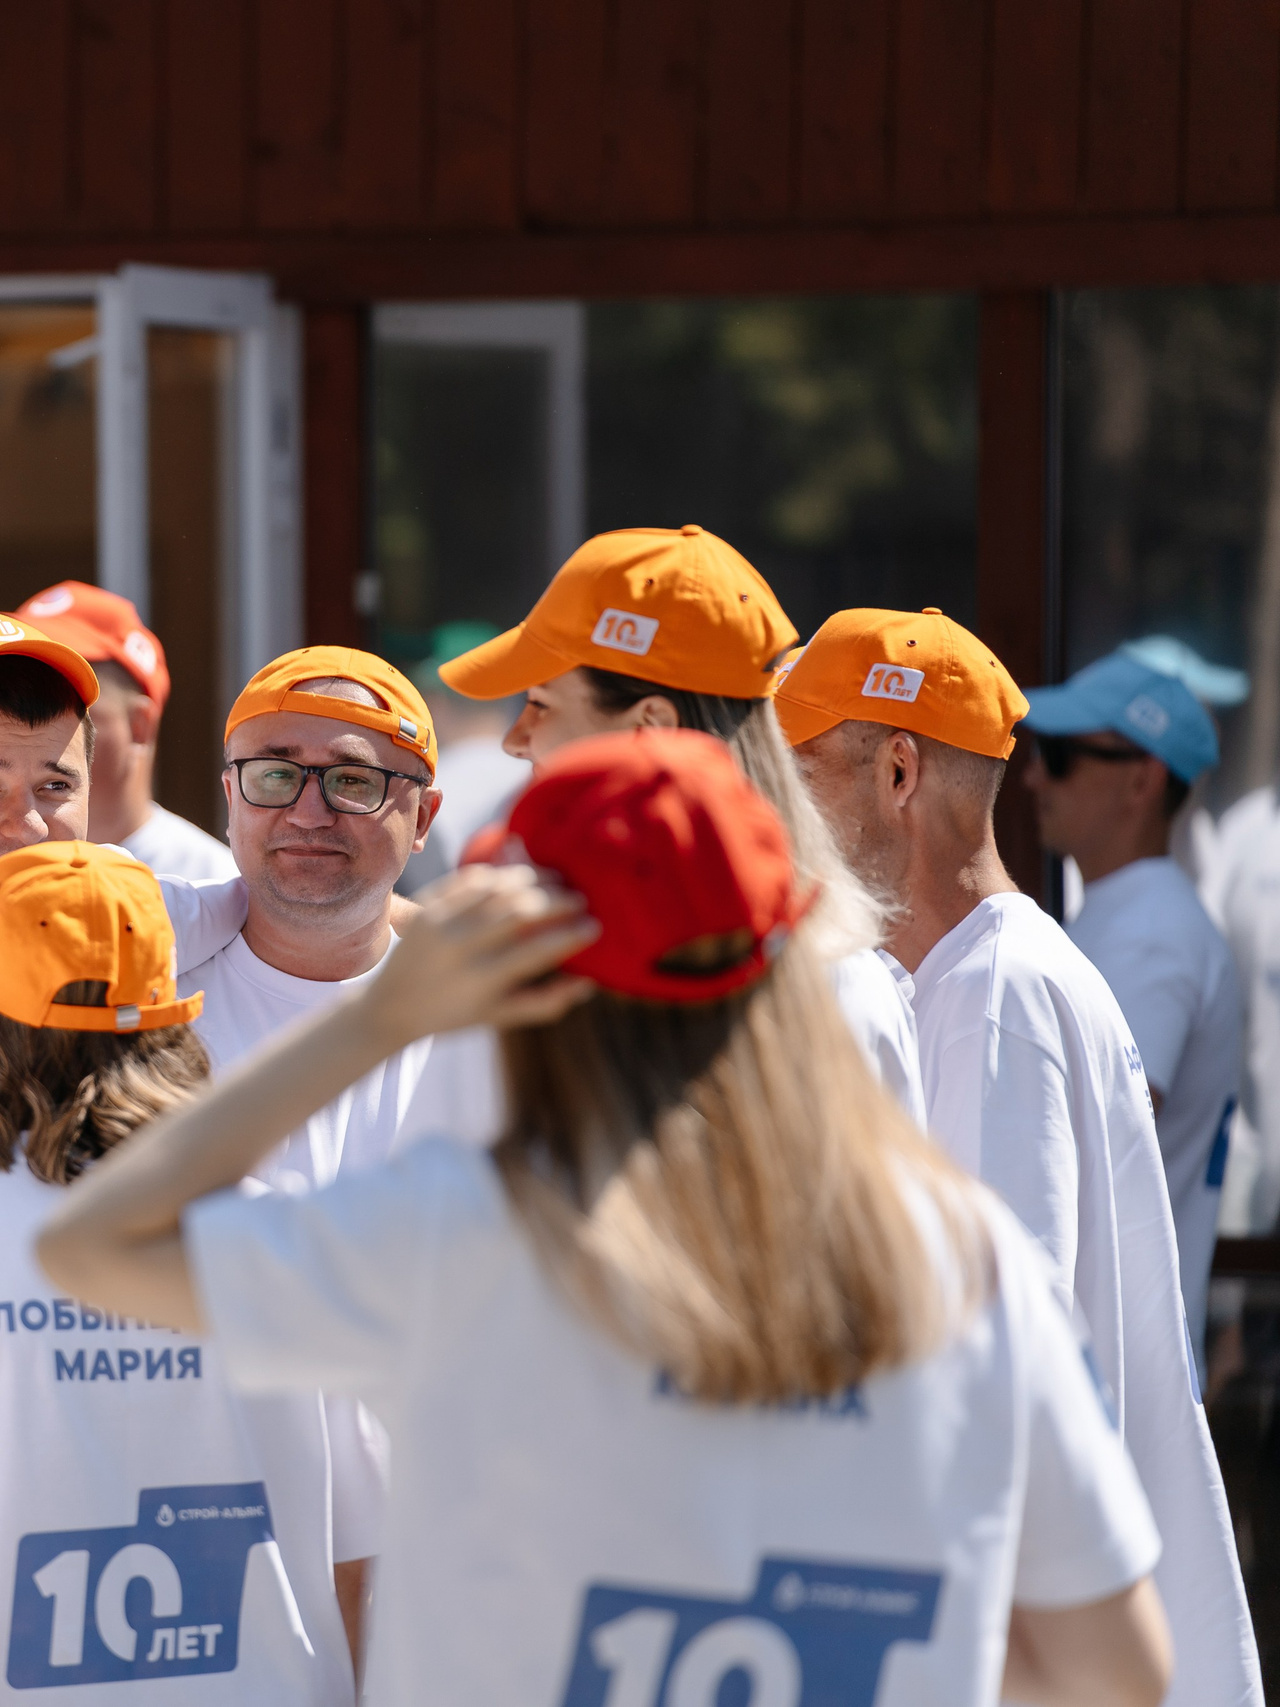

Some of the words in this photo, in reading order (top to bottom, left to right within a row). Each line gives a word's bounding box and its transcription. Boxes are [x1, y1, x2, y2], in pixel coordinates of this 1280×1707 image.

[603, 616, 637, 642] 10
[871, 668, 906, 693] 10
[55, 1346, 203, 1381] МАРИЯ
[32, 1542, 184, 1668] 10
[146, 1623, 224, 1663] ЛЕТ
[588, 1606, 805, 1707] 10
